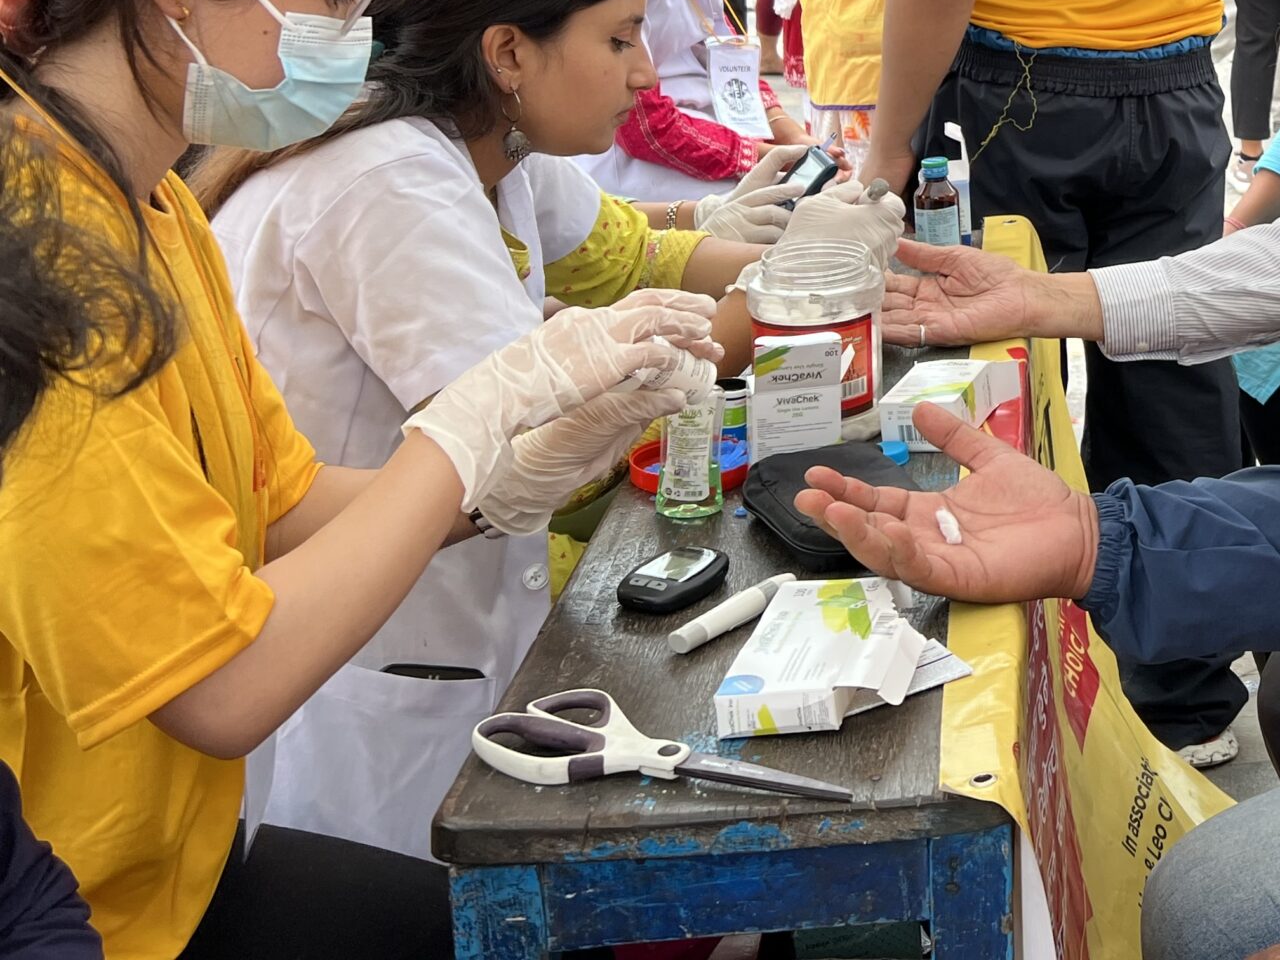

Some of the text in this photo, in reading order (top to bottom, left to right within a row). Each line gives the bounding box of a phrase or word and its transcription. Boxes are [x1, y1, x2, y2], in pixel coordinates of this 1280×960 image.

[771, 371, 823, 383] VivaChek
[776, 394, 820, 406] VivaChek
[1062, 628, 1086, 699] CHOIC
[1121, 757, 1158, 858] In associati
[1147, 824, 1167, 860] Leo
[1157, 797, 1174, 823] Cl
